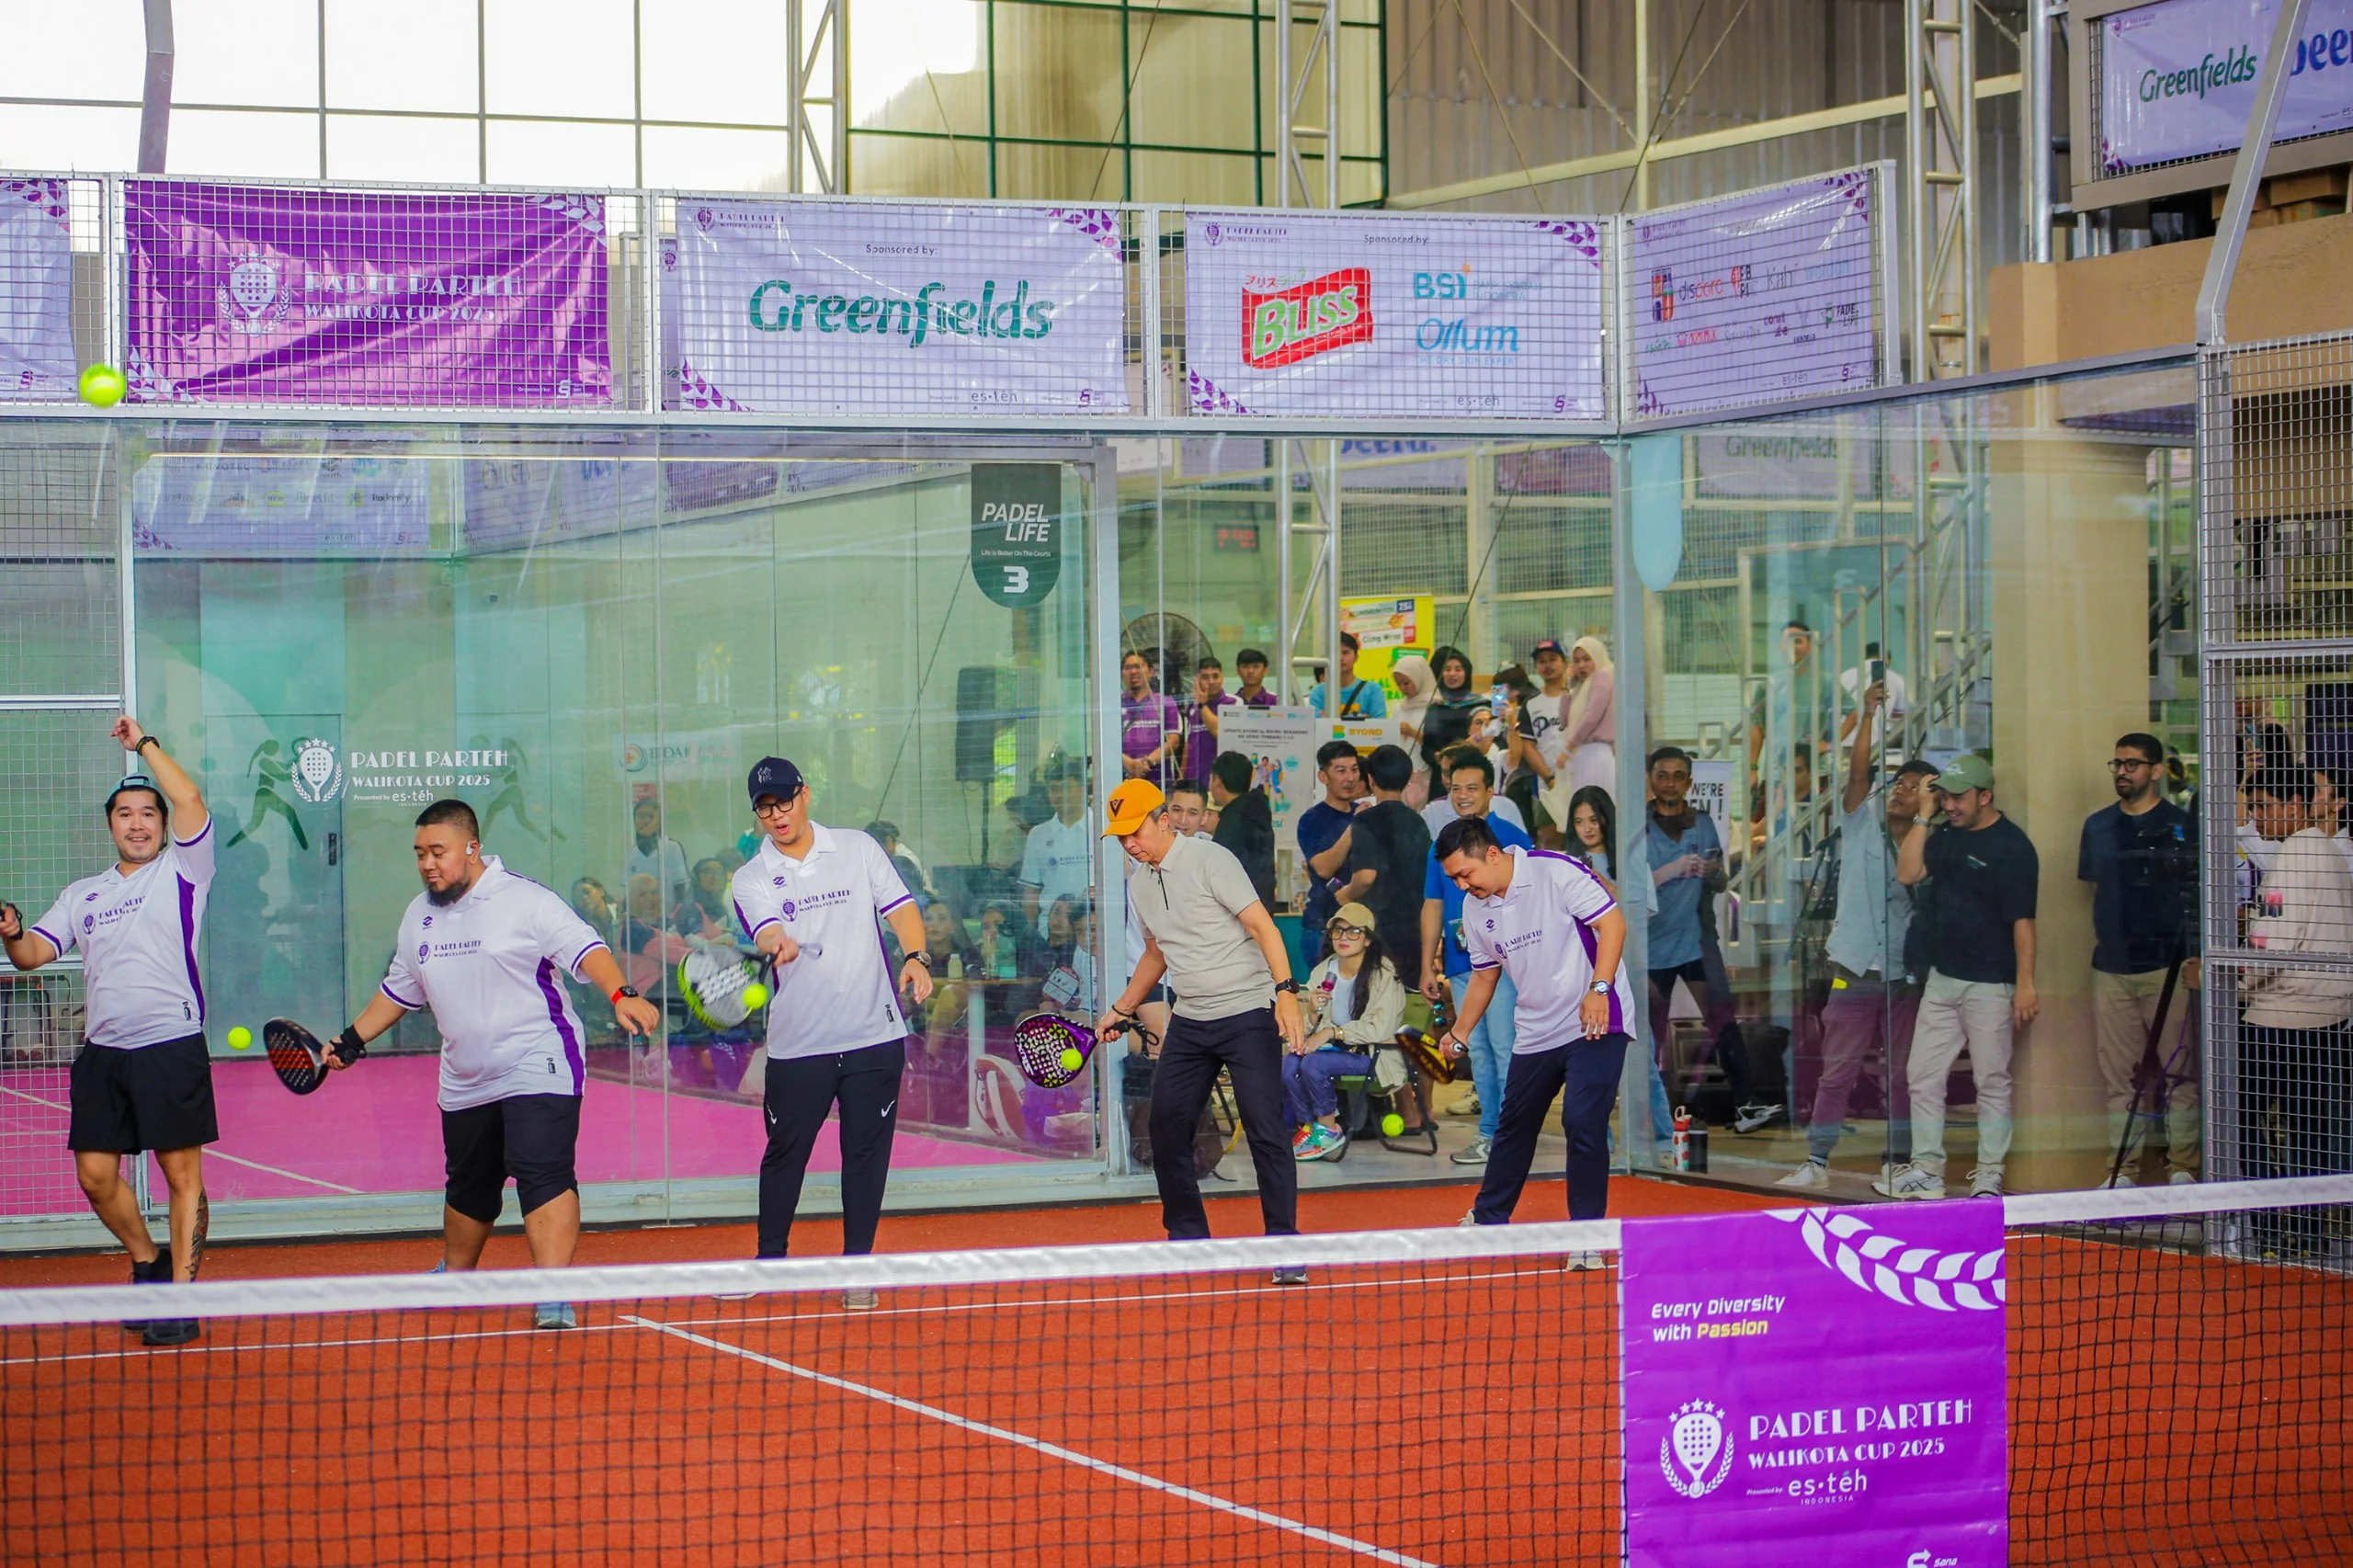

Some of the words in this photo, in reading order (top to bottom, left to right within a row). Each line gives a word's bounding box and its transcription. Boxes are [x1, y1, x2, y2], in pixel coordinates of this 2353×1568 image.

[2140, 44, 2257, 103] Greenfields
[866, 244, 919, 255] Sponsored
[922, 245, 938, 256] by:
[1364, 233, 1414, 244] Sponsored
[1415, 236, 1429, 245] by:
[304, 272, 401, 294] PADEL
[409, 274, 523, 296] PARTEH
[1413, 268, 1469, 300] BSI
[304, 304, 401, 320] WALIKOTA
[405, 305, 445, 321] CUP
[449, 306, 495, 322] 2025
[749, 278, 1056, 349] Greenfields
[1253, 285, 1359, 361] BLISS
[1416, 318, 1520, 352] Ollum
[1458, 356, 1480, 365] SKIN
[982, 502, 1049, 522] PADEL
[1005, 522, 1051, 542] LIFE
[1004, 566, 1029, 593] 3
[351, 751, 419, 768] PADEL
[426, 750, 508, 767] PARTEH
[352, 776, 423, 788] WALIKOTA
[426, 775, 455, 787] CUP
[458, 774, 491, 786] 2025
[1651, 1301, 1702, 1319] Every
[1707, 1294, 1786, 1315] Diversity
[1654, 1324, 1691, 1342] with
[1697, 1319, 1768, 1339] Passion
[1749, 1408, 1847, 1441] PADEL
[1856, 1398, 1972, 1433] PARTEH
[1747, 1446, 1849, 1470] WALIKOTA
[1854, 1442, 1896, 1461] CUP
[1899, 1437, 1946, 1458] 2025
[1746, 1487, 1774, 1495] Presented
[1774, 1486, 1783, 1494] by:
[1801, 1494, 1854, 1506] INDONESIA
